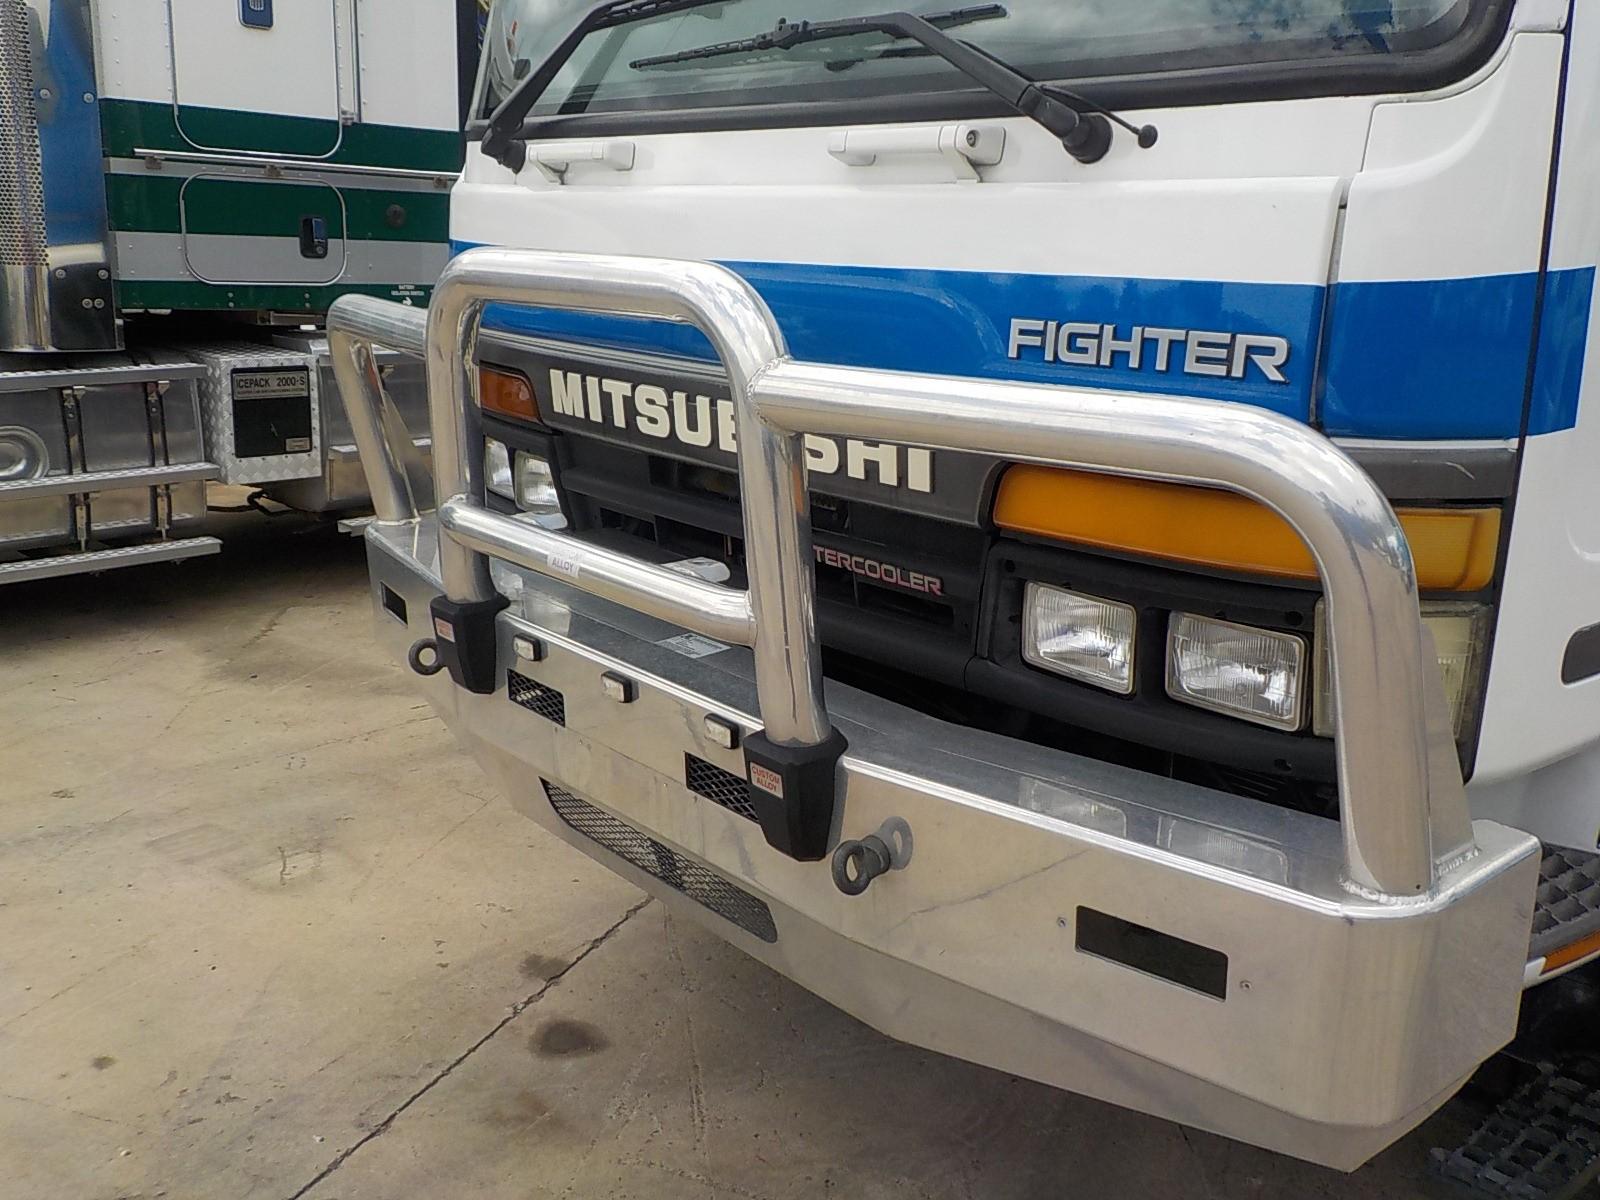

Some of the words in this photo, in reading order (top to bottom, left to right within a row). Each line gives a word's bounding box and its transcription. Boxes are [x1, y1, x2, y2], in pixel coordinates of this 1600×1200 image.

[1008, 318, 1290, 383] FIGHTER
[236, 377, 271, 389] ICEPACK
[276, 375, 306, 387] 2000-S
[550, 368, 933, 493] MITSUBSHI
[551, 556, 575, 573] ALLOY
[812, 544, 942, 595] TERCOOLER
[751, 766, 780, 785] CUSTOM
[756, 776, 777, 792] ALLOY
